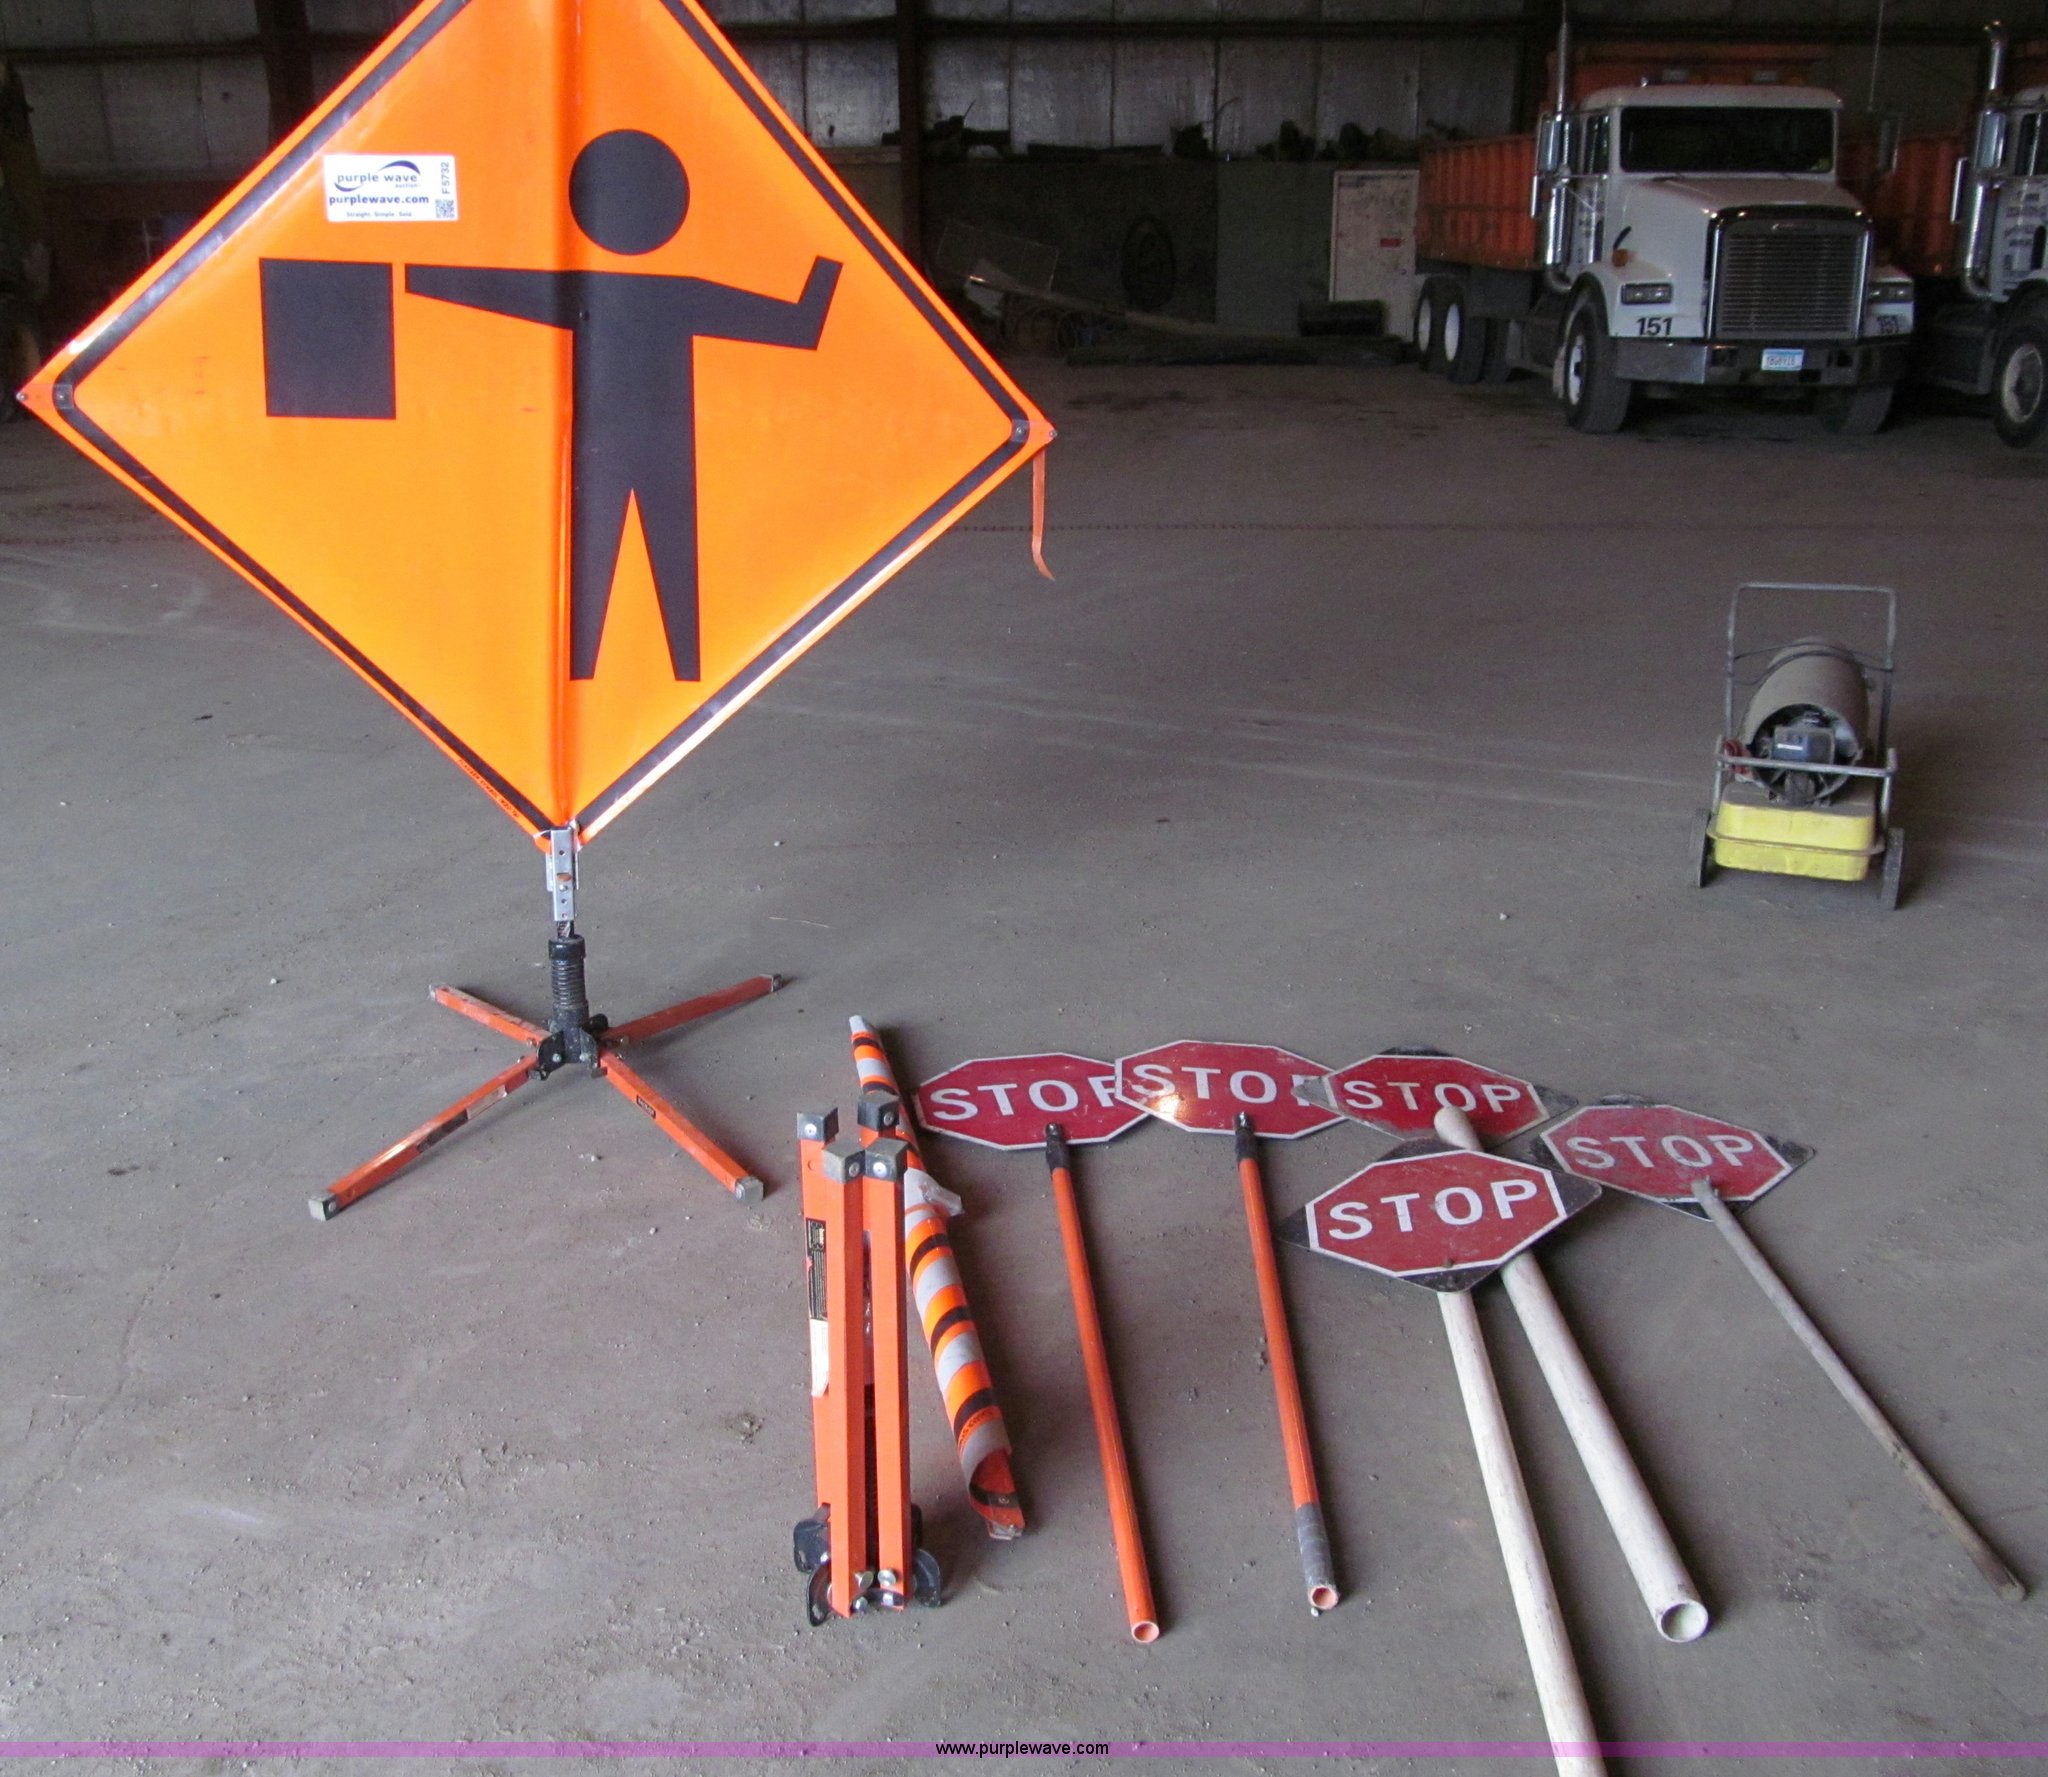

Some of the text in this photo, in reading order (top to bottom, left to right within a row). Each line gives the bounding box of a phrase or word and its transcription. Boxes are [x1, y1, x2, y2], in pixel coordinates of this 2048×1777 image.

[337, 172, 418, 184] purple wave
[329, 194, 429, 206] purplewave.com
[1636, 317, 1673, 336] 151
[1343, 1081, 1521, 1113] STOP
[1566, 1134, 1754, 1170] STOP
[1328, 1179, 1538, 1241] STOP
